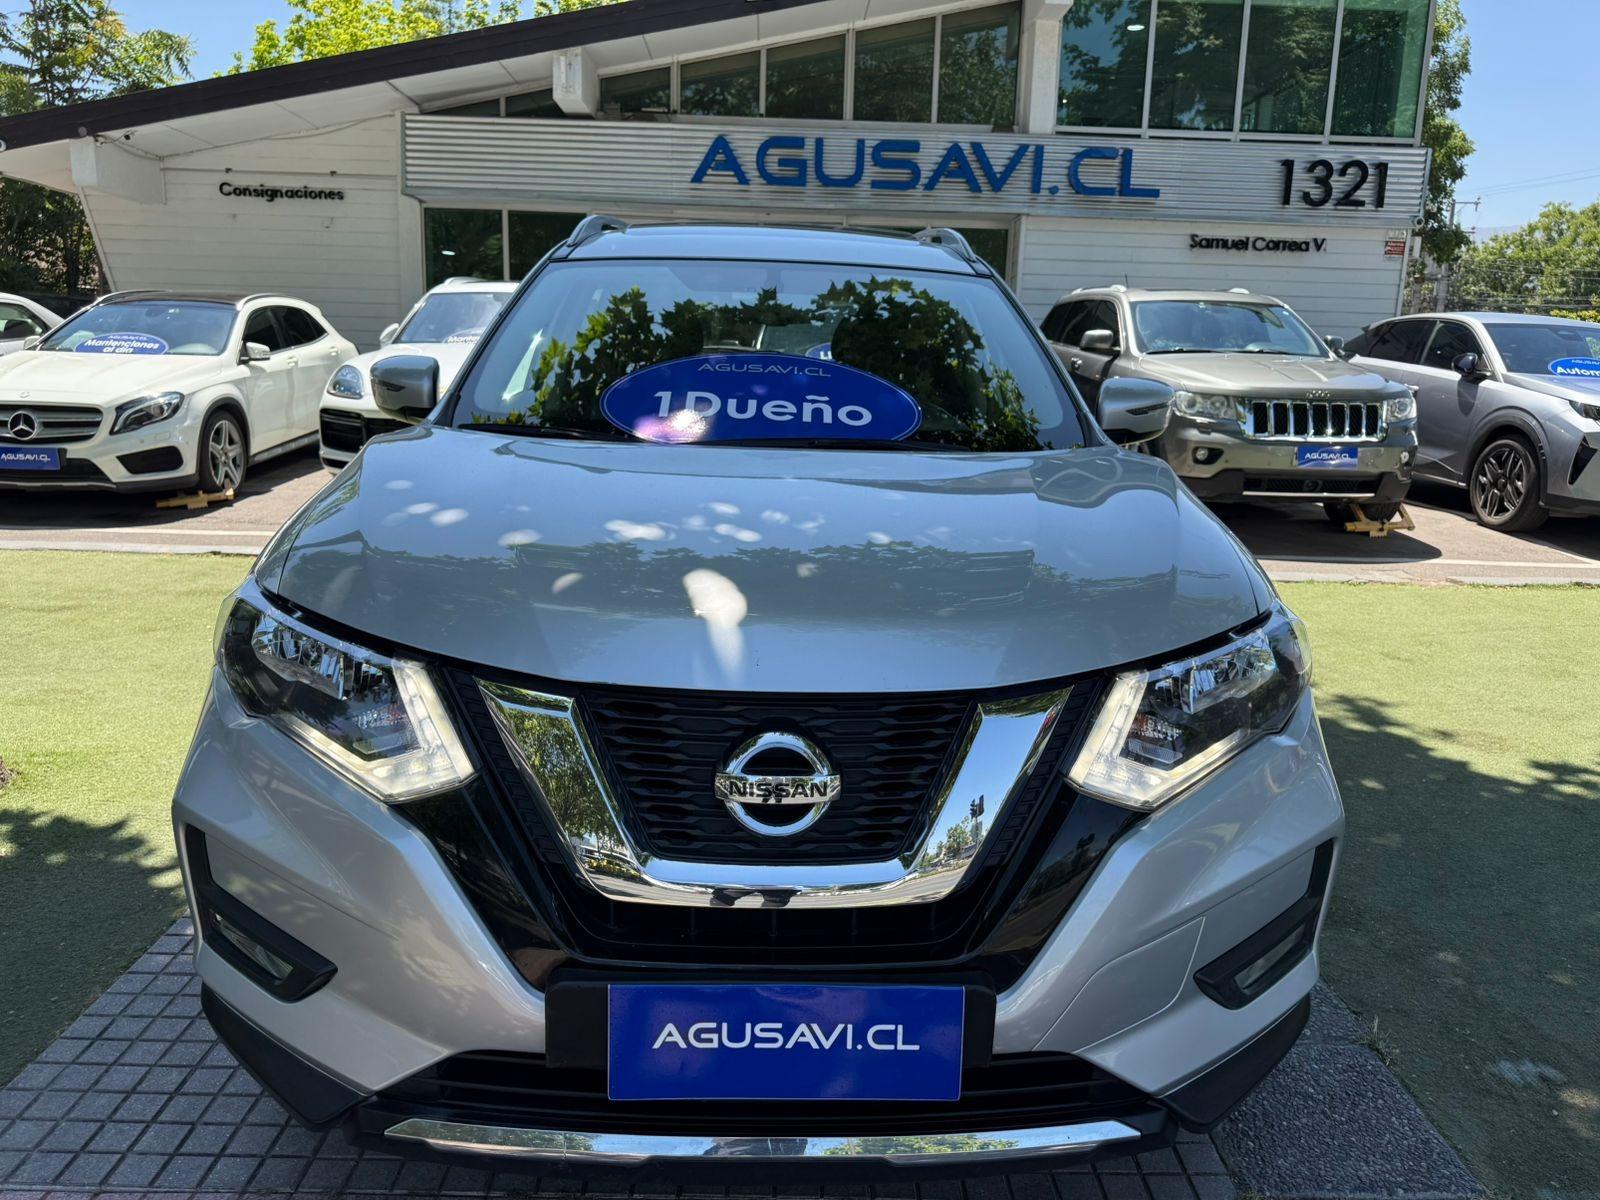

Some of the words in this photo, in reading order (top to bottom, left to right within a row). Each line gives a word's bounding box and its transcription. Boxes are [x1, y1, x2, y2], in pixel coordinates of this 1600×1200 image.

[690, 134, 1160, 199] AGUSAVI.CL
[219, 182, 344, 202] Consignaciones
[1281, 159, 1388, 209] 1321
[1190, 234, 1249, 251] Samuel
[1252, 237, 1310, 252] Correa
[84, 339, 160, 349] Mantenciones
[698, 363, 831, 377] AGUSAVI.CL
[684, 391, 872, 426] Dueño
[1, 453, 51, 461] AGUSAVI.CL
[728, 781, 829, 798] NISSAN
[652, 1022, 920, 1050] AGUSAVI.CL
